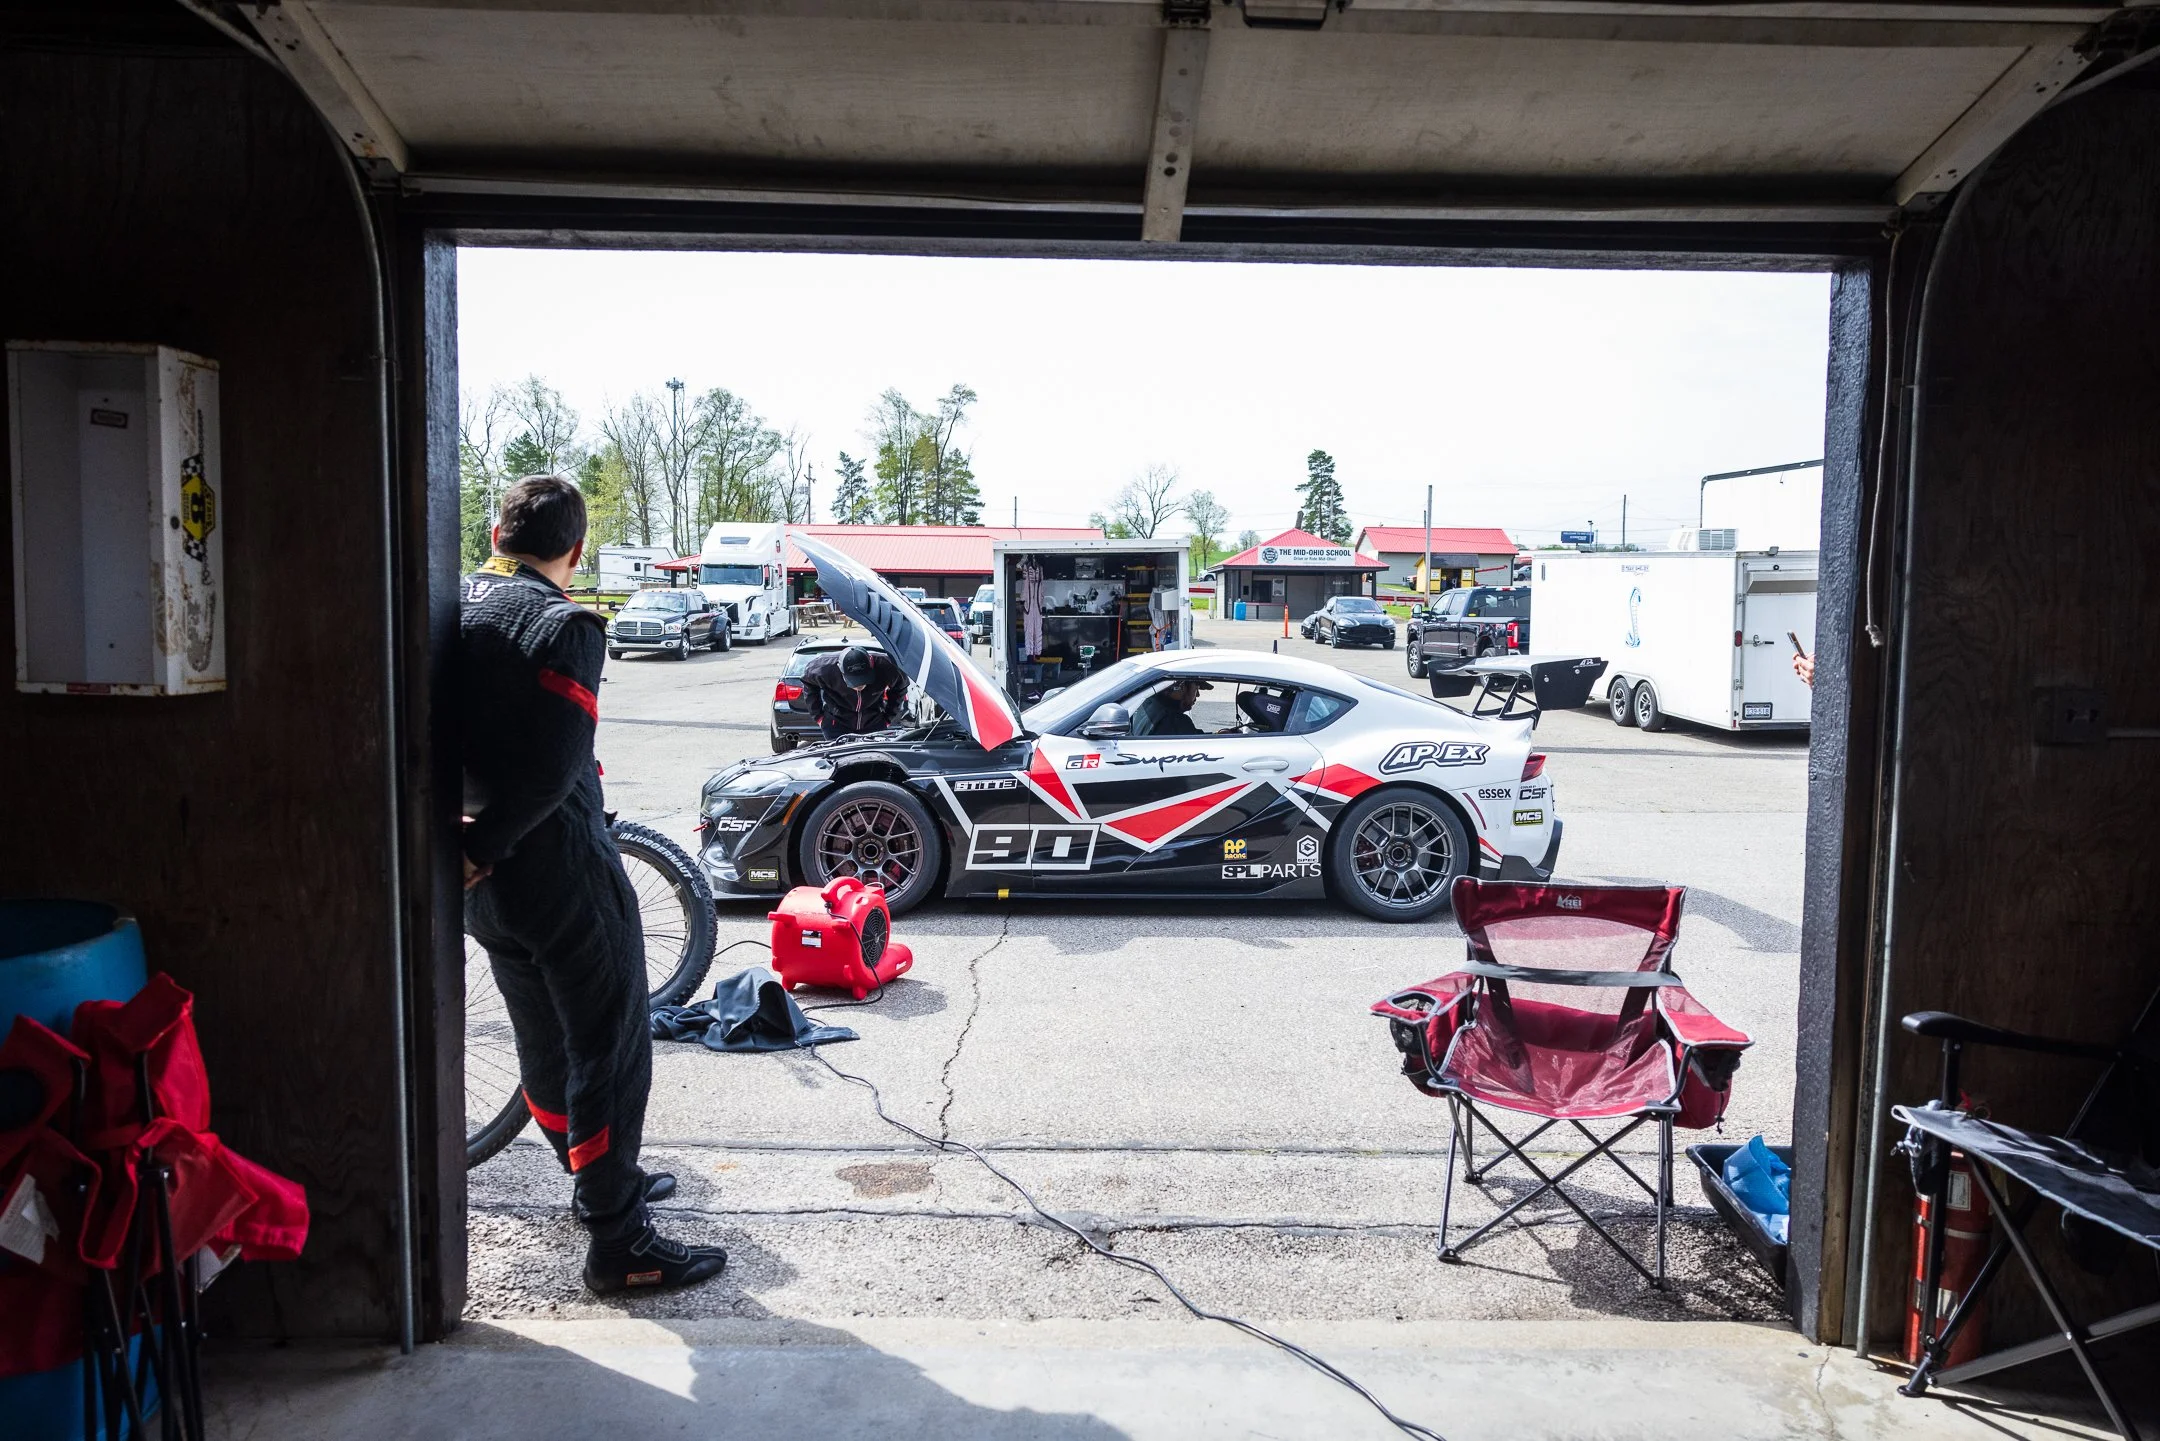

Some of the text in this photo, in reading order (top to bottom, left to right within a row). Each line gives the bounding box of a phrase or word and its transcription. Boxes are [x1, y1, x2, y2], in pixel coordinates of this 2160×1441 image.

[1279, 548, 1292, 556] THE
[1293, 549, 1325, 557] MID-OHIO
[1325, 549, 1352, 557] SCHOOL
[1386, 743, 1484, 768] APEX
[1066, 753, 1224, 773] GR Supra
[1478, 788, 1511, 799] essex
[1519, 787, 1547, 800] CSF
[1515, 811, 1542, 821] MCS
[717, 820, 757, 831] CSF
[966, 824, 1100, 870] 90
[1224, 839, 1246, 853] AP
[630, 835, 694, 879] JUGGERNAUT
[750, 870, 776, 878] MCS
[1565, 899, 1582, 907] REI
